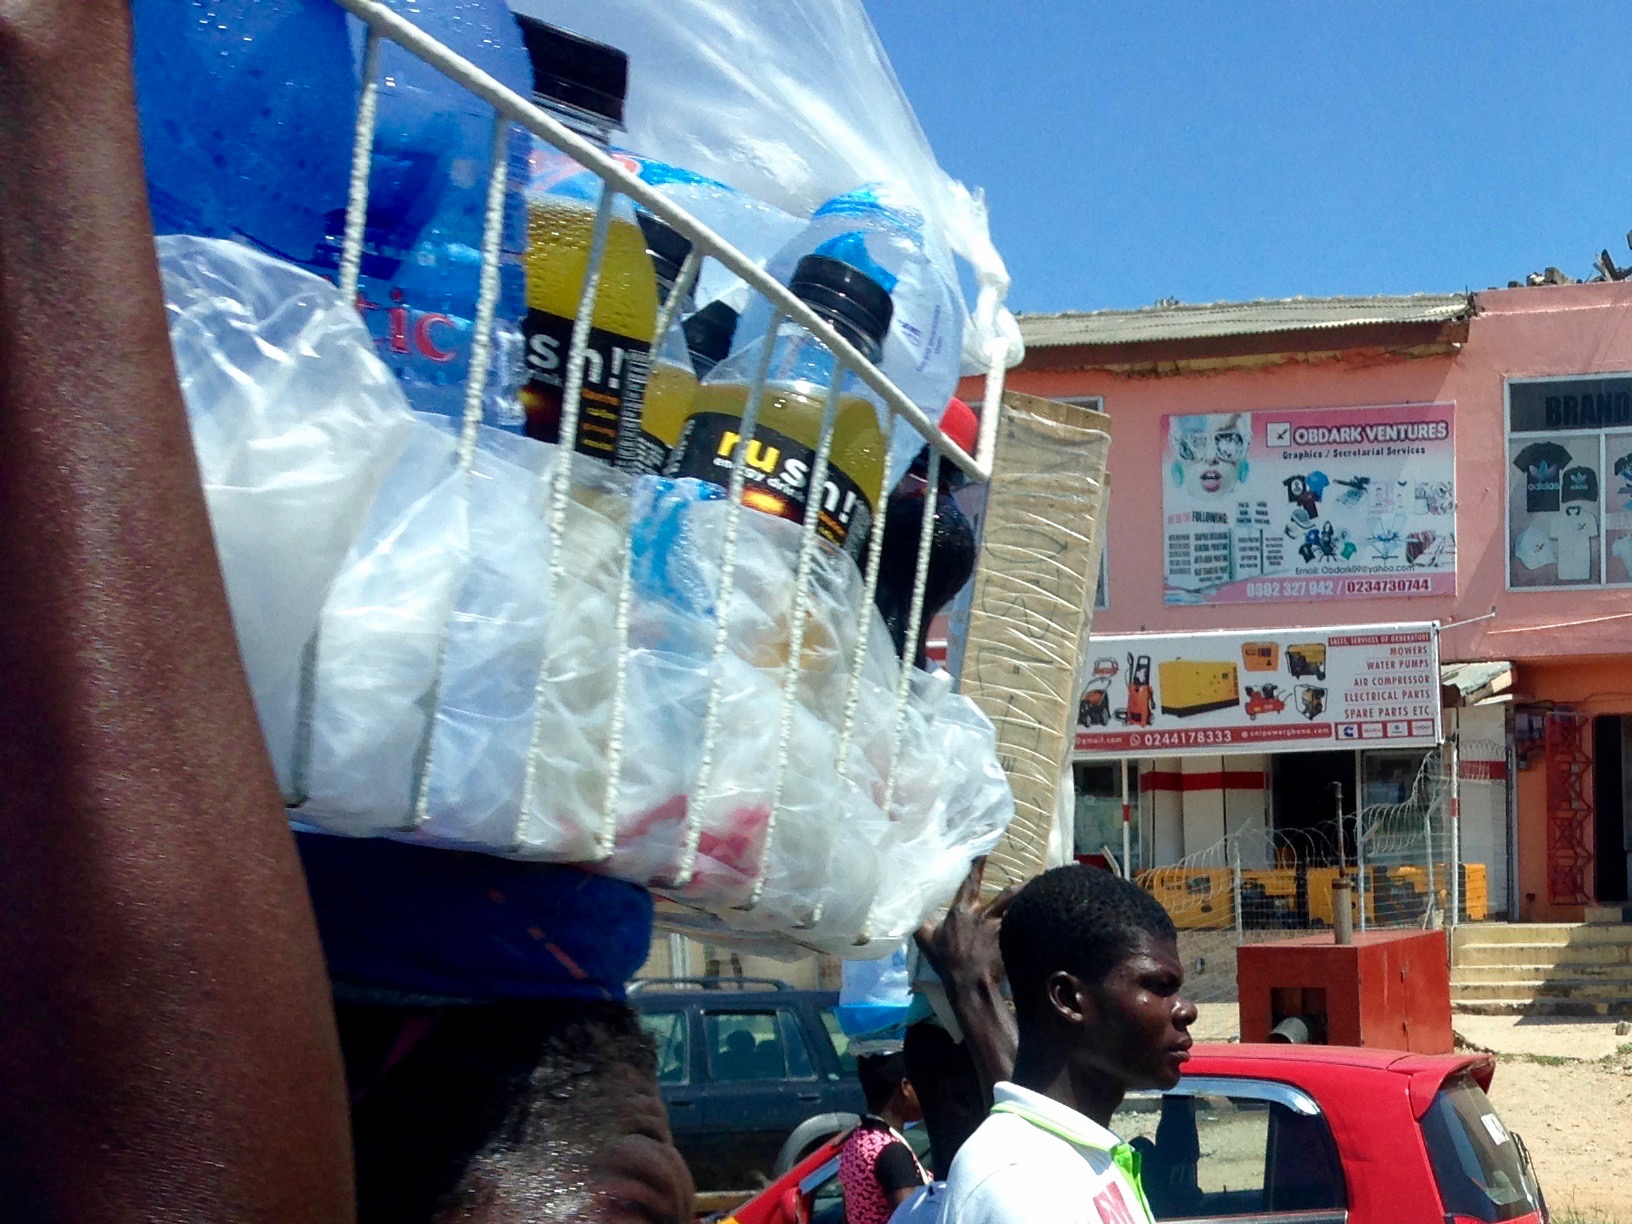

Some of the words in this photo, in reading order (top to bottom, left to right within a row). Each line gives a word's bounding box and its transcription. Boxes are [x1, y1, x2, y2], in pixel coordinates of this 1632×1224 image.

[1294, 426, 1363, 446] OBDARK
[1364, 421, 1449, 442] VENTURES
[1283, 450, 1322, 460] Graphics
[1333, 448, 1384, 458] Secretarial
[1386, 445, 1426, 456] Services
[1390, 646, 1428, 656] MOWERS
[1366, 661, 1396, 670] WATER
[1399, 659, 1429, 669] PUMPS
[1354, 677, 1369, 687] AIR
[1372, 675, 1430, 687] COMPRESSOR
[1344, 690, 1398, 702] ELECTRICAL
[1402, 689, 1430, 699] PARTS
[1344, 708, 1374, 719] SPARE
[1379, 706, 1408, 717] PARTS
[1144, 730, 1232, 747] 0244178333
